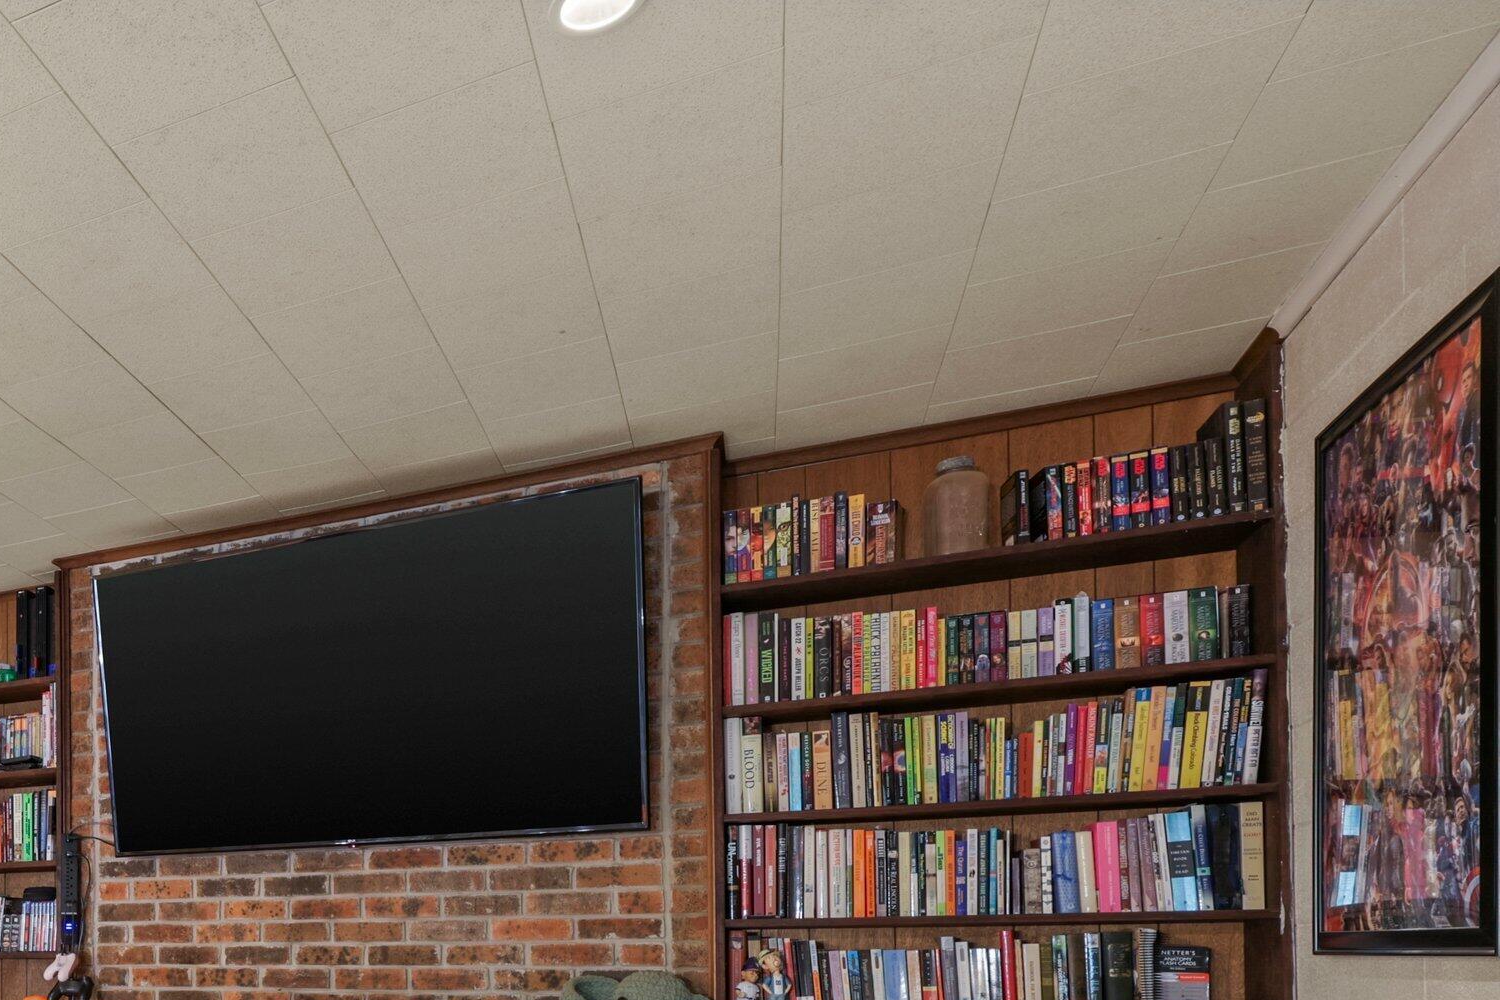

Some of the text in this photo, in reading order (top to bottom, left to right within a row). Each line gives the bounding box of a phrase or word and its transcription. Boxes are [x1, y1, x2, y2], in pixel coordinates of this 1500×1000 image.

[819, 647, 830, 682] ORCS
[853, 615, 862, 680] CHUCK PALAHNIUK
[761, 649, 773, 684] WICKED
[744, 749, 756, 789] BLOOD
[816, 761, 828, 795] DUNE
